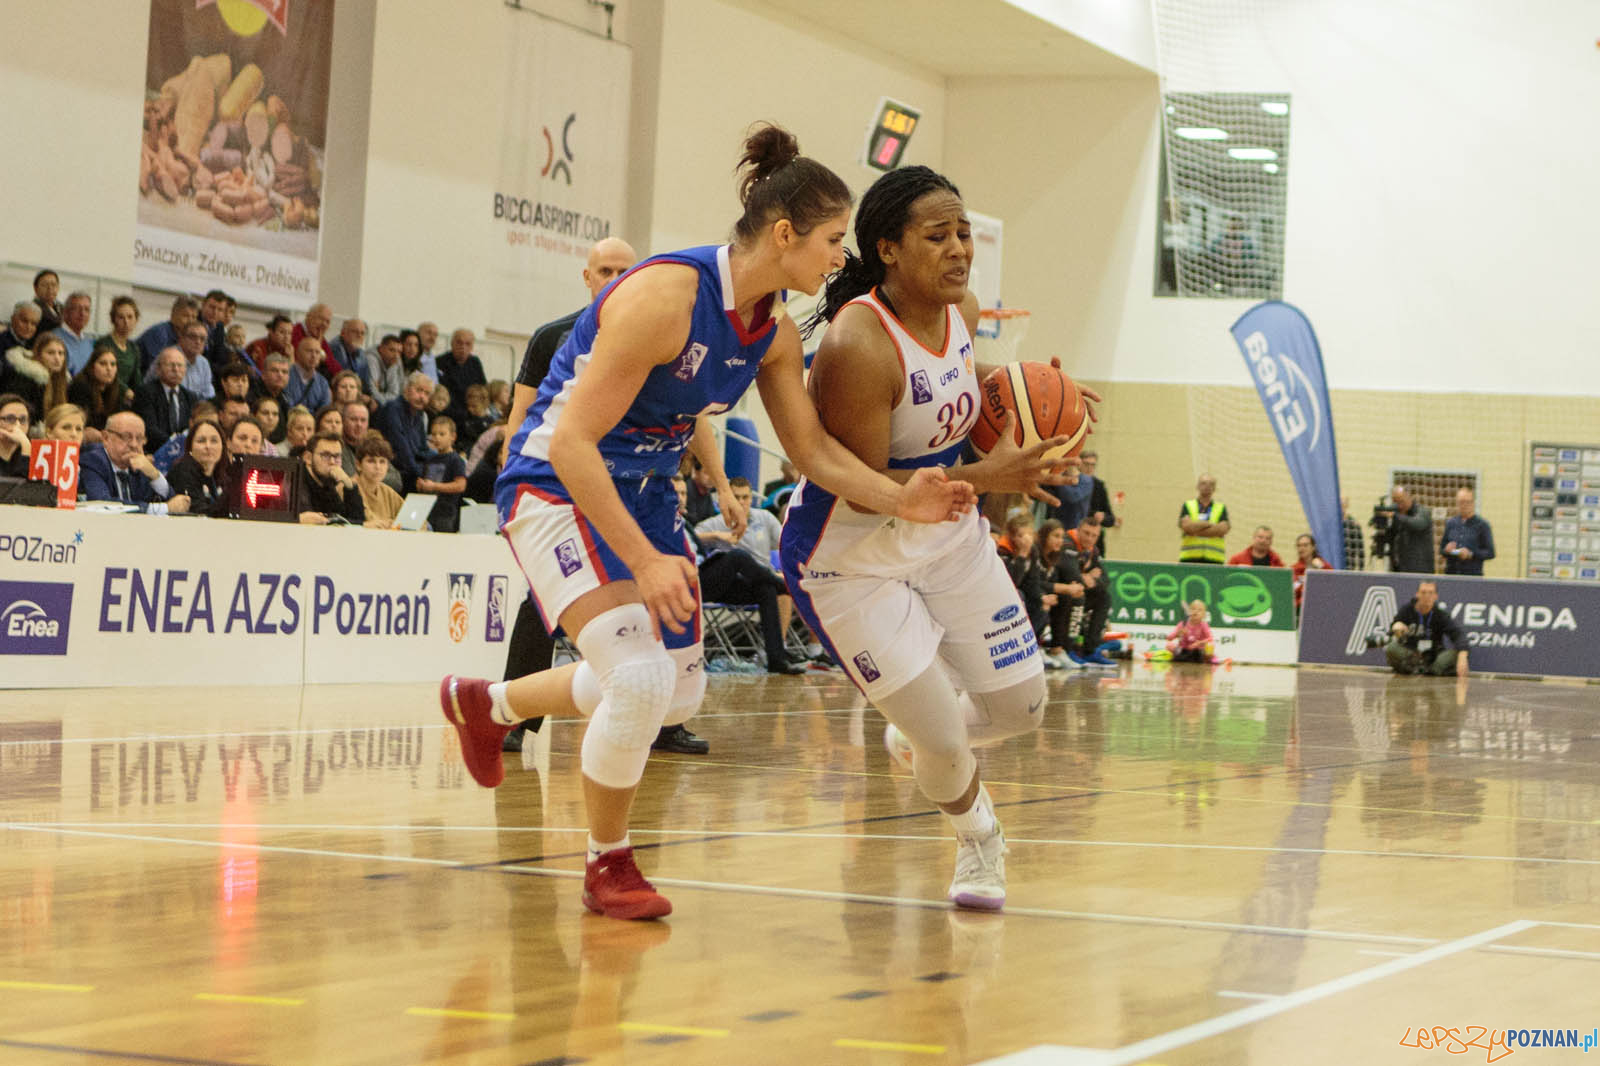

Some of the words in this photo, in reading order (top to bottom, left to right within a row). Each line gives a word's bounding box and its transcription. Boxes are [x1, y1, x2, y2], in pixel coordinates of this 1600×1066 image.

[134, 239, 194, 271] Smaczne,
[198, 253, 250, 282] Zdrowe,
[255, 265, 311, 293] Drobiowe
[928, 391, 974, 449] 32
[8, 613, 59, 637] Enea
[99, 567, 215, 633] ENEA
[224, 573, 302, 634] AZS
[313, 575, 430, 635] Poznań
